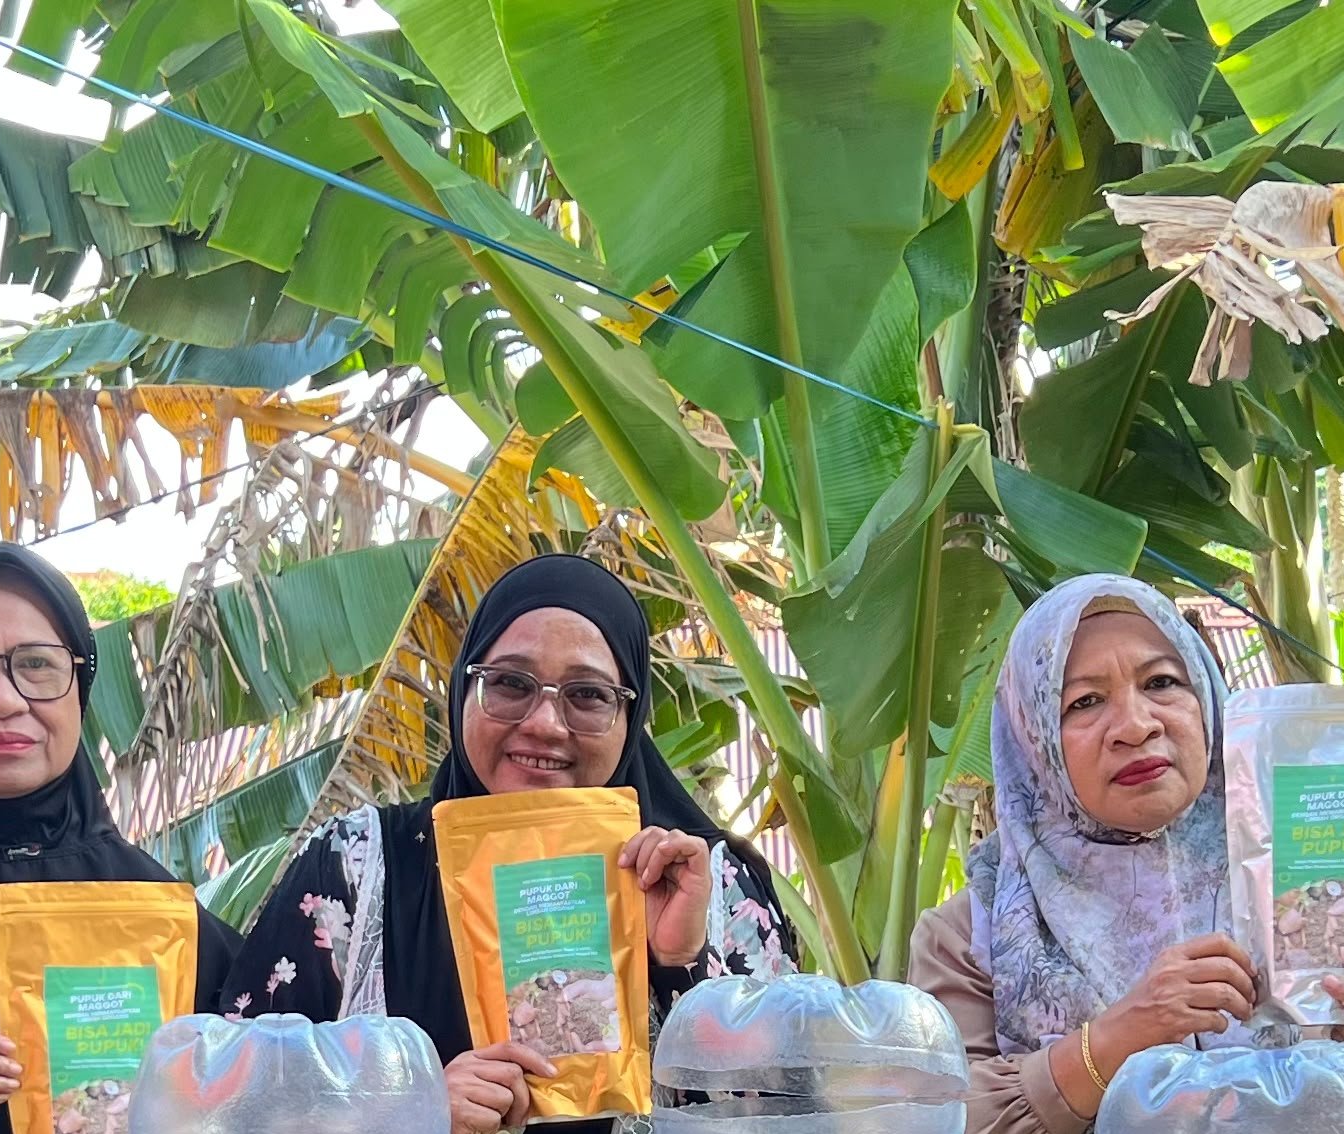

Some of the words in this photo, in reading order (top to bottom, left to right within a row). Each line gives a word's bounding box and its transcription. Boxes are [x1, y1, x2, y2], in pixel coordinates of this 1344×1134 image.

[1299, 791, 1336, 802] PUPUK
[519, 884, 553, 899] PUPUK
[555, 881, 578, 892] DARI
[69, 992, 106, 1004] PUPUK
